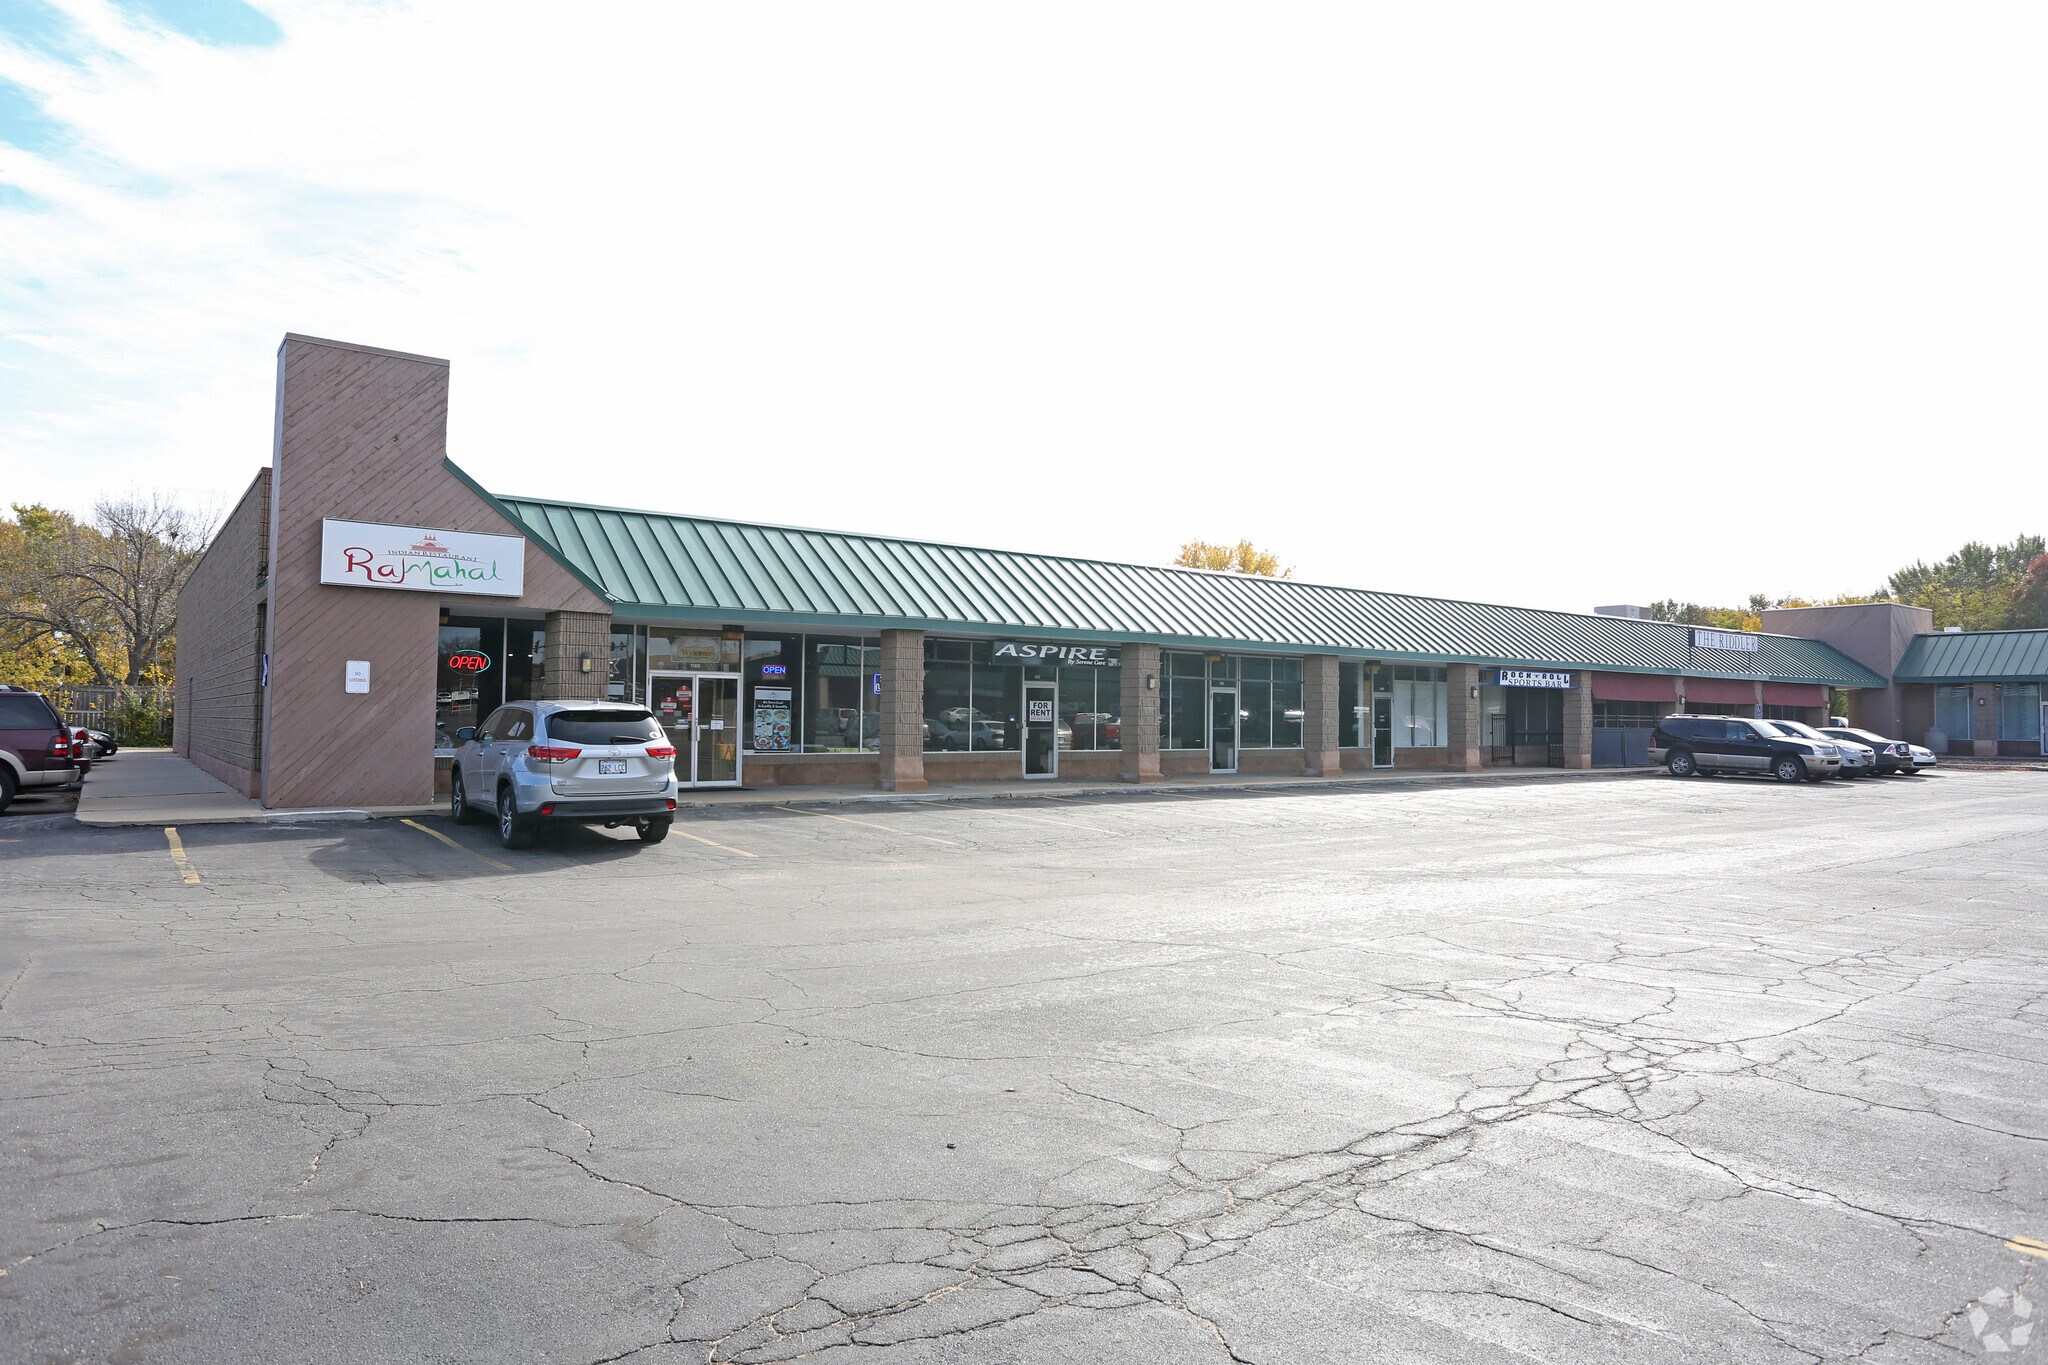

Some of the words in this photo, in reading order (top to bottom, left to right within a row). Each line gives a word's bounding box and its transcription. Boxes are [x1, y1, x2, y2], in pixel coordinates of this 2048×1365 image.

[388, 549, 419, 557] INDIAN
[423, 551, 479, 562] RESTAURANT
[1697, 630, 1715, 646] THE
[1719, 634, 1757, 651] RIDDLER
[995, 644, 1107, 660] ASPIRE
[449, 655, 488, 669] OPEN
[762, 665, 786, 674] OPEN
[1501, 671, 1532, 681] ROCK
[1542, 673, 1569, 684] ROLL
[1508, 678, 1543, 687] SPORTS
